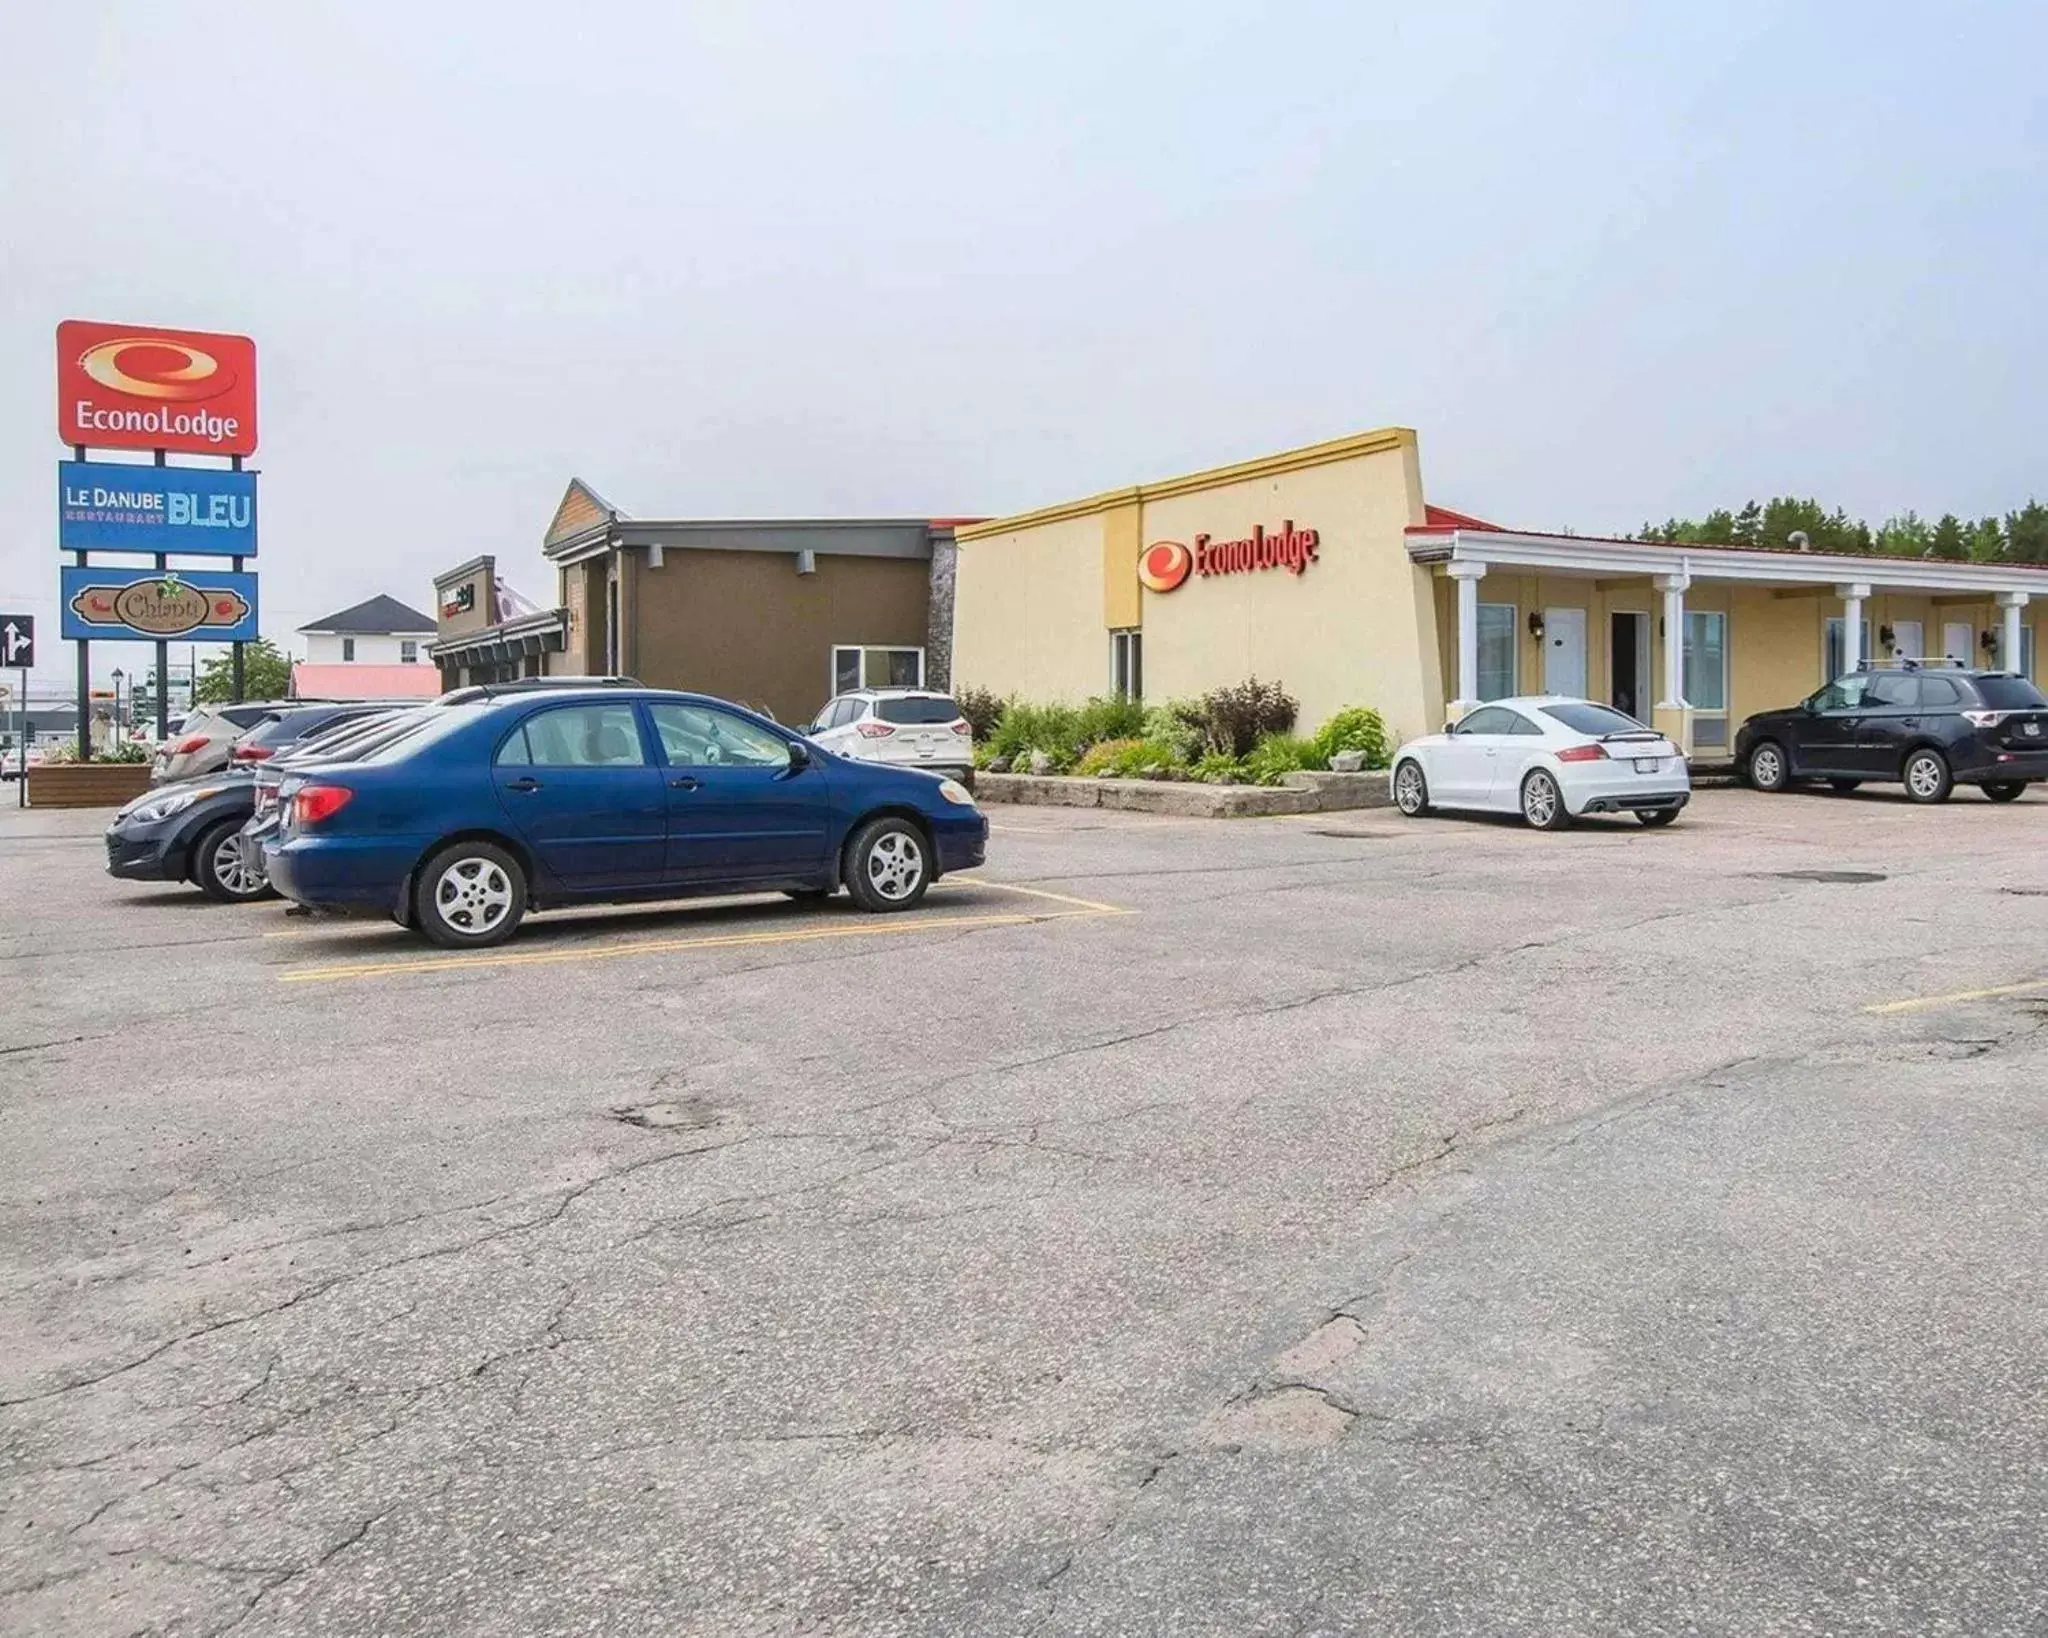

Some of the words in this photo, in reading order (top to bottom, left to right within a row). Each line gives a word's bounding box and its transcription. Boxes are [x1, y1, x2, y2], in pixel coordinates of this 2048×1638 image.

[76, 400, 239, 442] EconoLodge
[66, 486, 90, 506] LE
[94, 488, 164, 510] DANUBE
[168, 492, 250, 528] BLEU
[1194, 519, 1320, 577] EconoLodge
